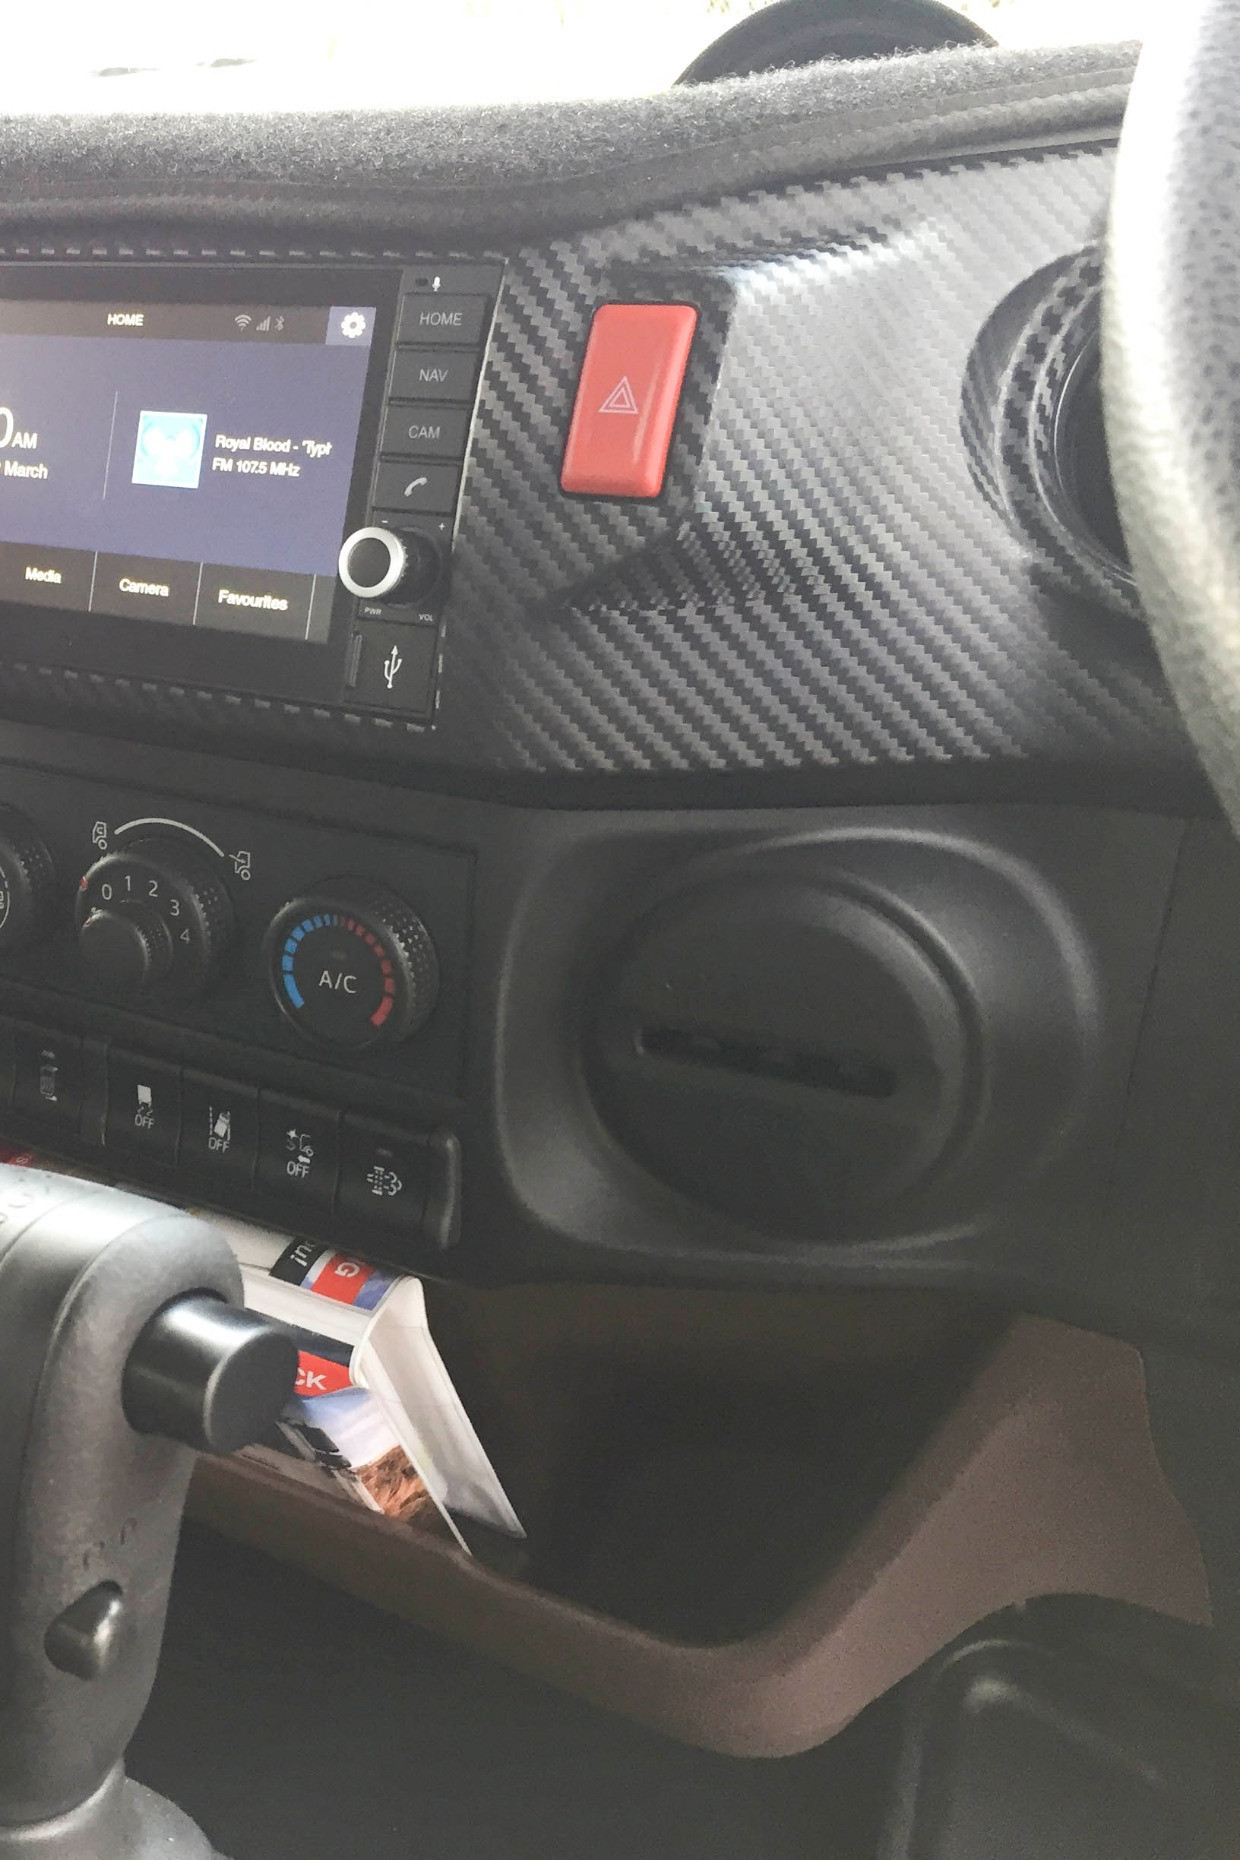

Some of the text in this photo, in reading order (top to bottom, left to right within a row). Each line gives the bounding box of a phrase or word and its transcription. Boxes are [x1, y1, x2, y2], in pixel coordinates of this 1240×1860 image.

[107, 313, 144, 326] HOME
[420, 312, 463, 326] HOME
[419, 369, 449, 382] NAV
[408, 426, 440, 439] CAM
[215, 434, 251, 452] Royal
[253, 437, 291, 453] Blood
[4, 460, 48, 480] March
[212, 457, 233, 472] FM
[269, 461, 300, 477] MHz
[25, 566, 62, 584] Media
[119, 578, 169, 597] Camera
[218, 589, 288, 611] Favourites
[364, 606, 382, 615] PWR
[419, 613, 433, 622] VOL
[101, 875, 190, 944] 0 1 2 3 4
[318, 970, 358, 994] A/C
[134, 1114, 154, 1129] OFF
[208, 1137, 230, 1153] OFF
[286, 1160, 310, 1179] OFF
